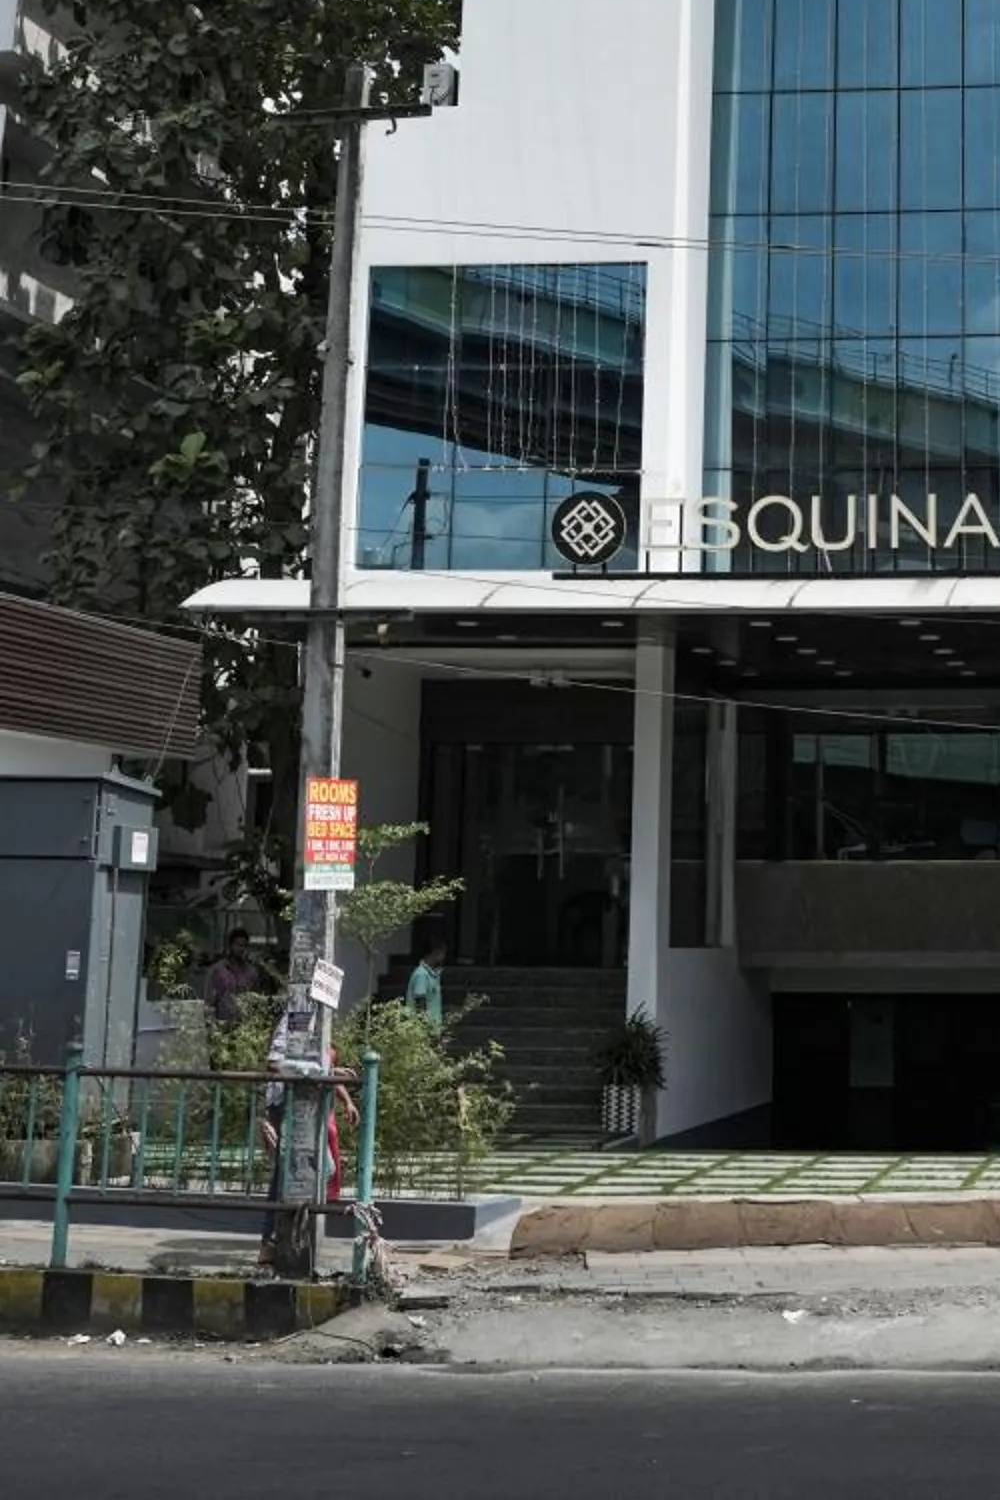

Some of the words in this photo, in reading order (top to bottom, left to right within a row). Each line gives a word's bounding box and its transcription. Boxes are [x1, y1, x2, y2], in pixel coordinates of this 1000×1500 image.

[643, 493, 1000, 552] ESQUINA
[309, 781, 356, 804] ROOMS
[308, 804, 341, 821] FRESH
[344, 805, 356, 822] UP
